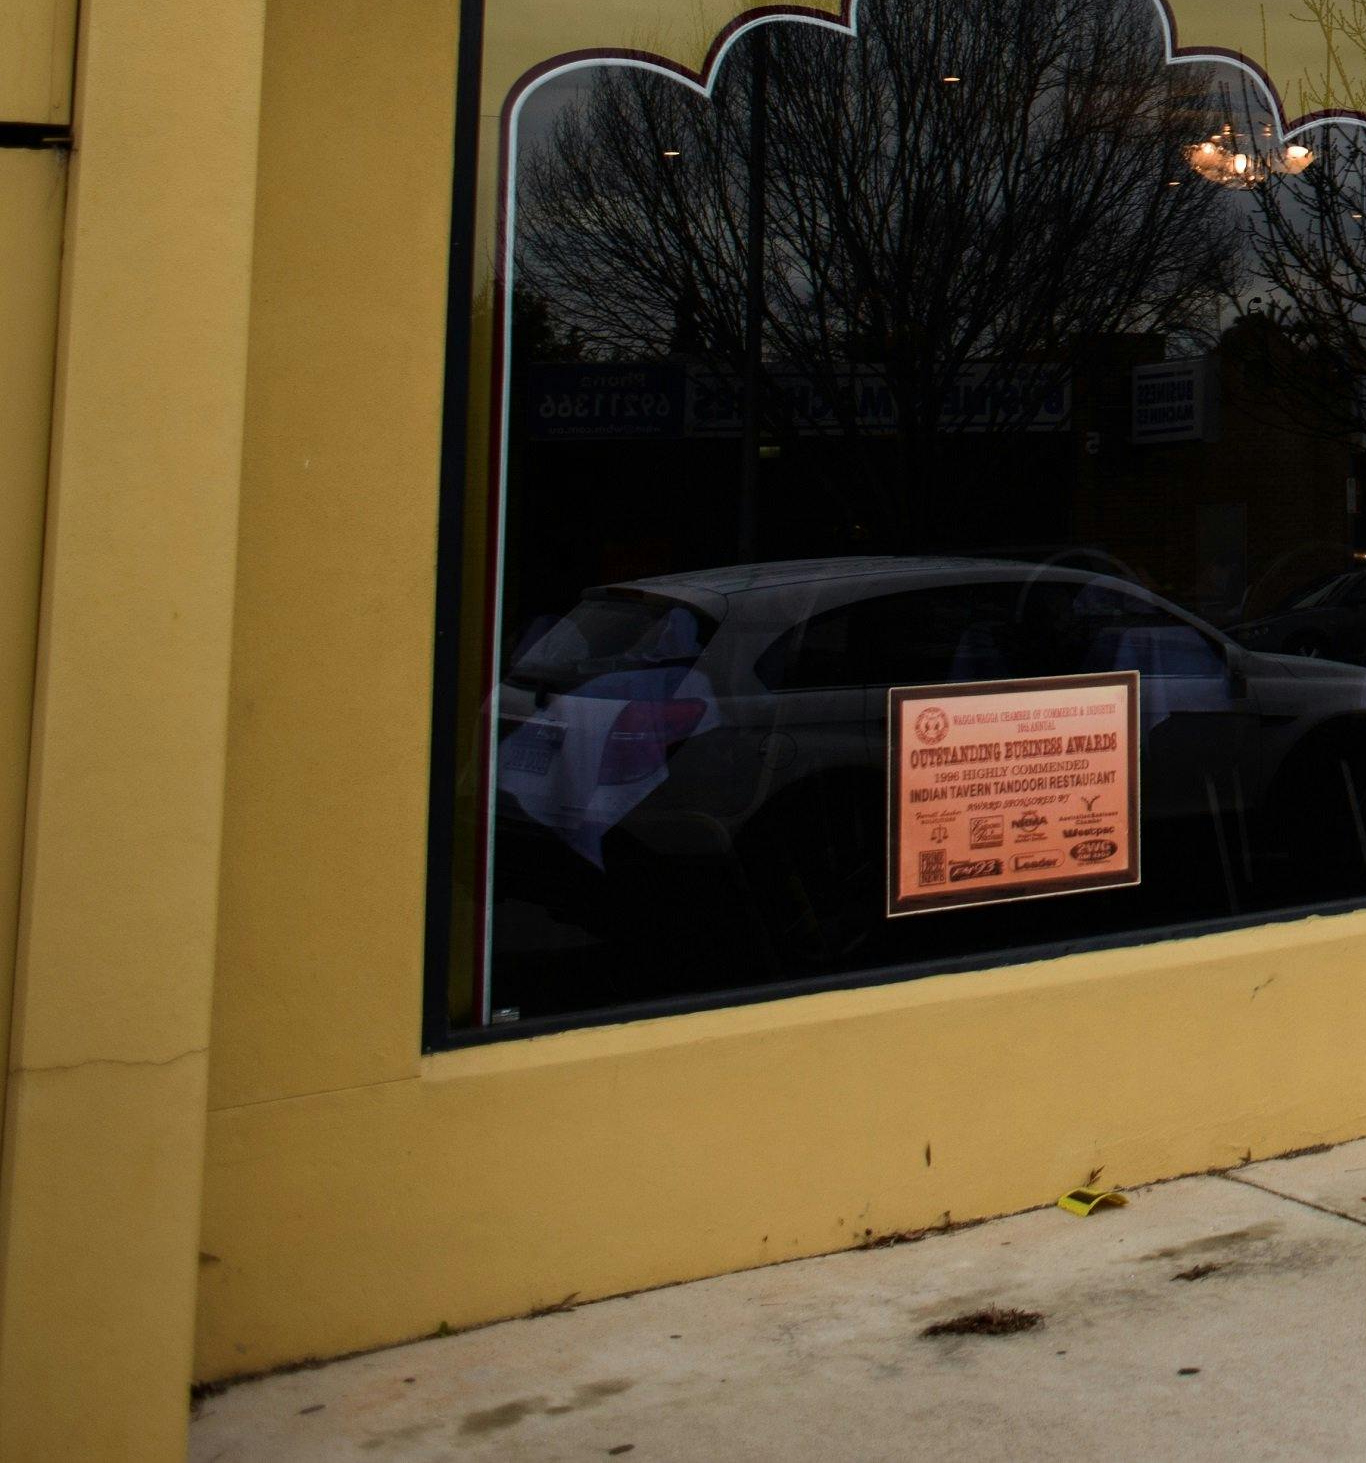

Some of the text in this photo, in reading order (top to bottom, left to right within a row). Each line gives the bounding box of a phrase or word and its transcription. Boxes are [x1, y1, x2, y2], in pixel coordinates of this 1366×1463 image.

[910, 732, 1118, 769] OUTSTANDING BUSINESS AWARDS
[962, 766, 1009, 781] HIGHLY
[1011, 758, 1090, 776] COMMENDED
[909, 770, 1117, 804] INDIAN TAVERN TANDOORI RESTAURANT
[1014, 857, 1058, 872] Leader
